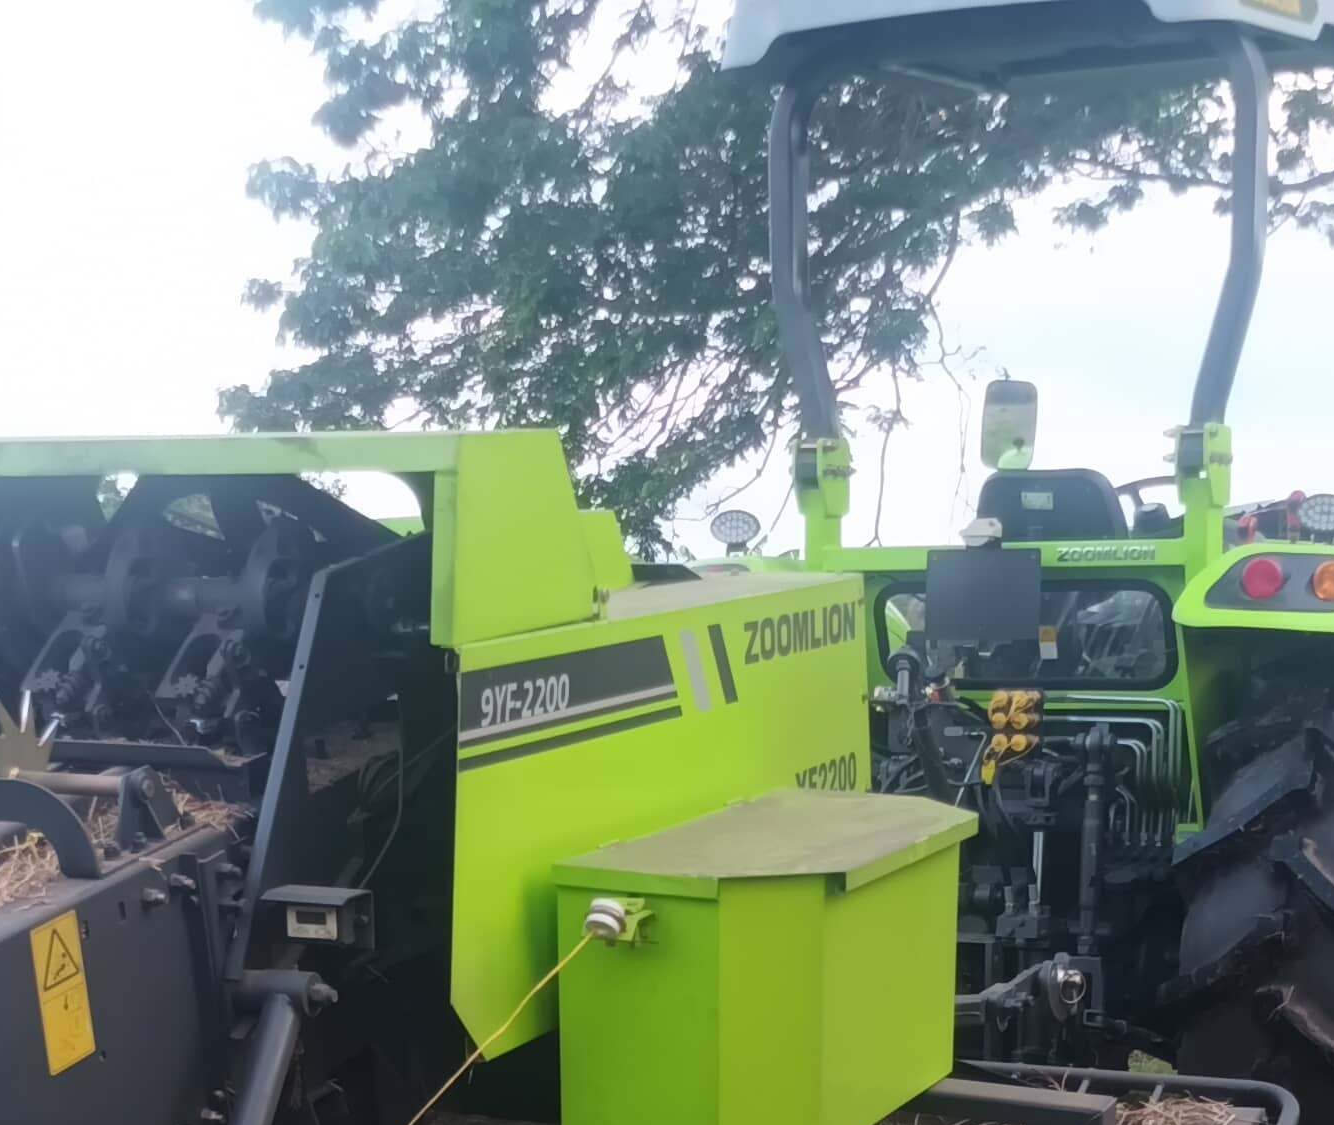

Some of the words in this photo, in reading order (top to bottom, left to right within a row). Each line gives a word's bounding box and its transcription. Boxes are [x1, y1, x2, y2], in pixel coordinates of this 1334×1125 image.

[1056, 546, 1156, 562] ZOOMLION
[744, 601, 856, 665] ZOOMLION
[481, 673, 570, 728] 9YF-2200
